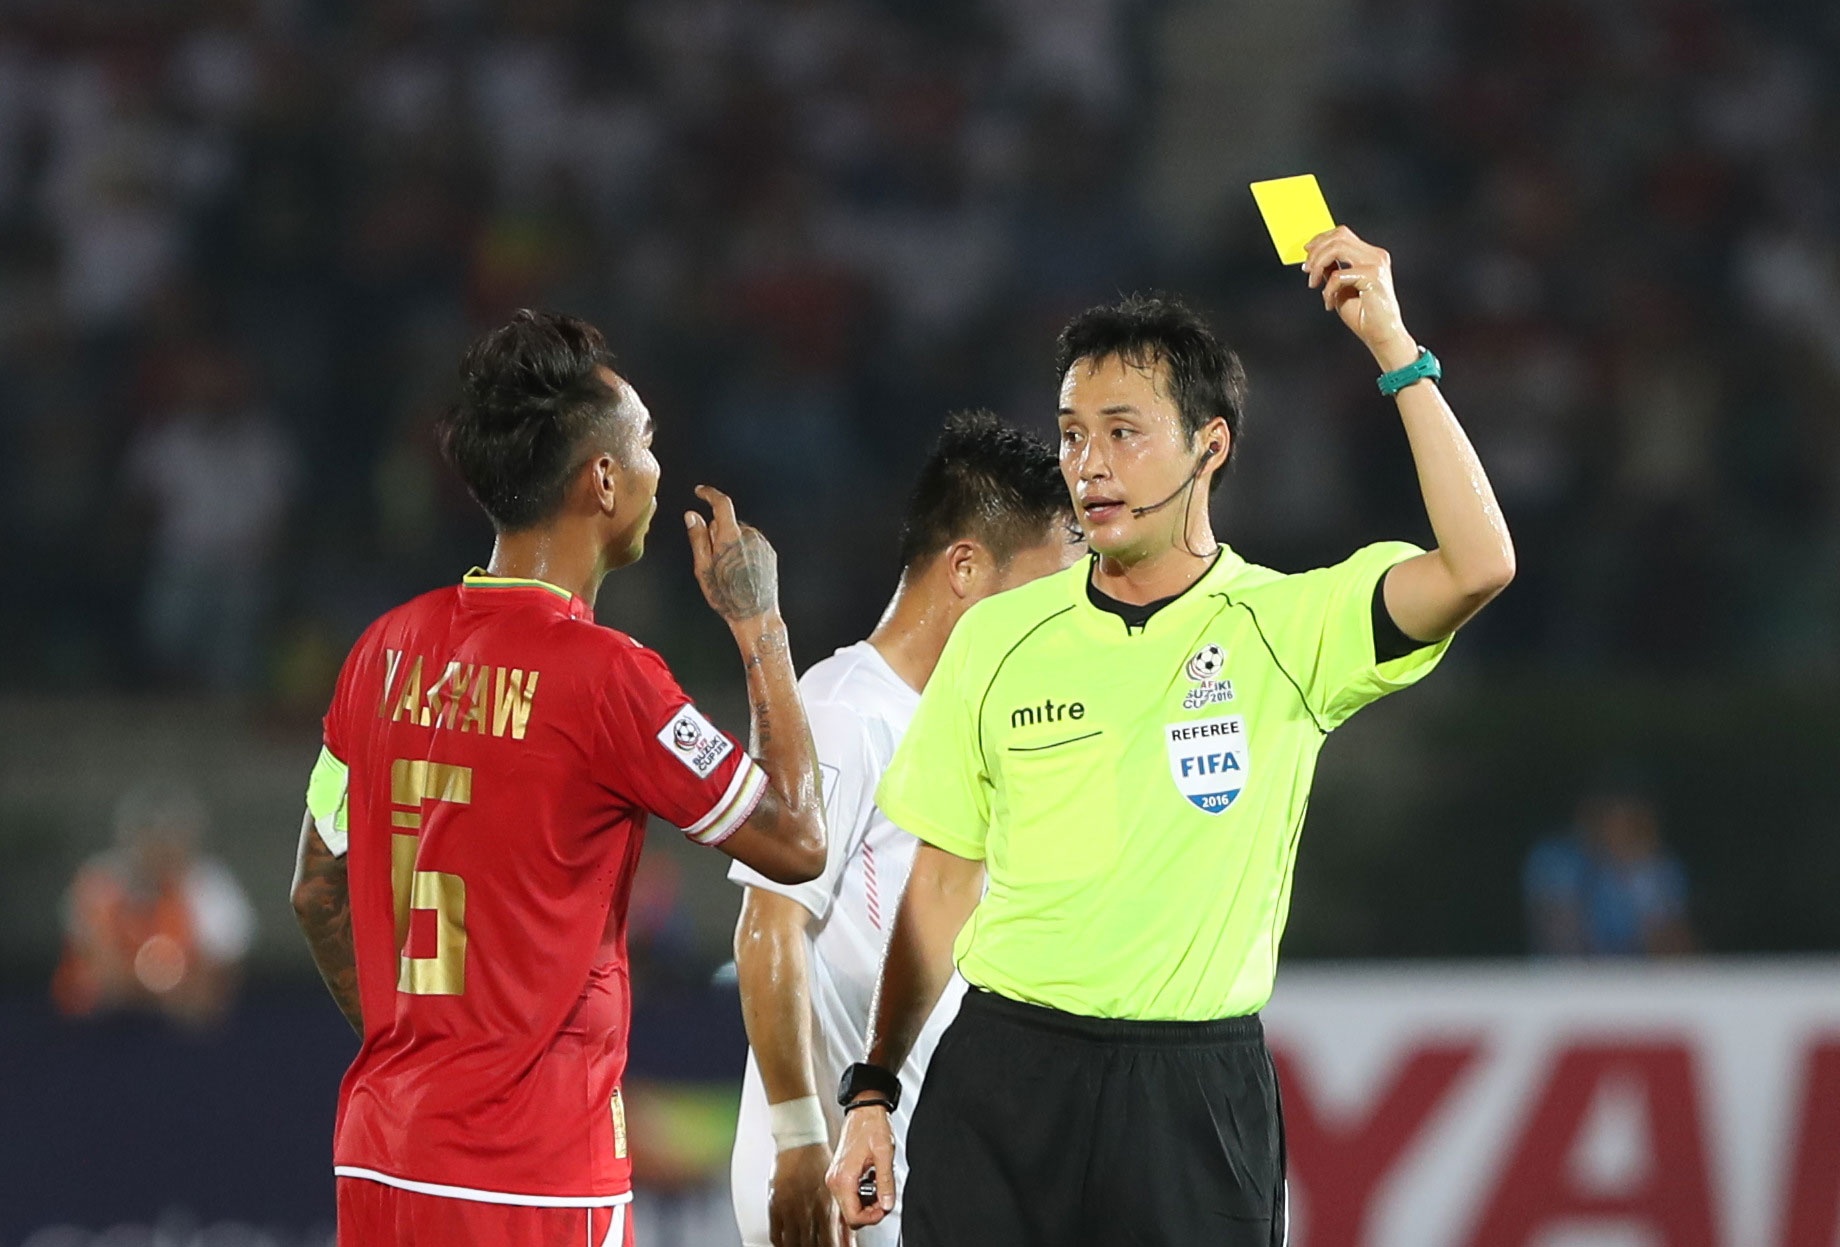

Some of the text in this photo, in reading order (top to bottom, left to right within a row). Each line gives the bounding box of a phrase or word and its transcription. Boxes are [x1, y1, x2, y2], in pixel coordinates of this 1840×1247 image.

[1211, 690, 1233, 702] 2016
[1011, 699, 1085, 728] mitre
[1171, 721, 1240, 741] REFEREE
[1180, 751, 1241, 778] FIFA
[1202, 794, 1229, 808] 2016
[390, 758, 472, 996] 6
